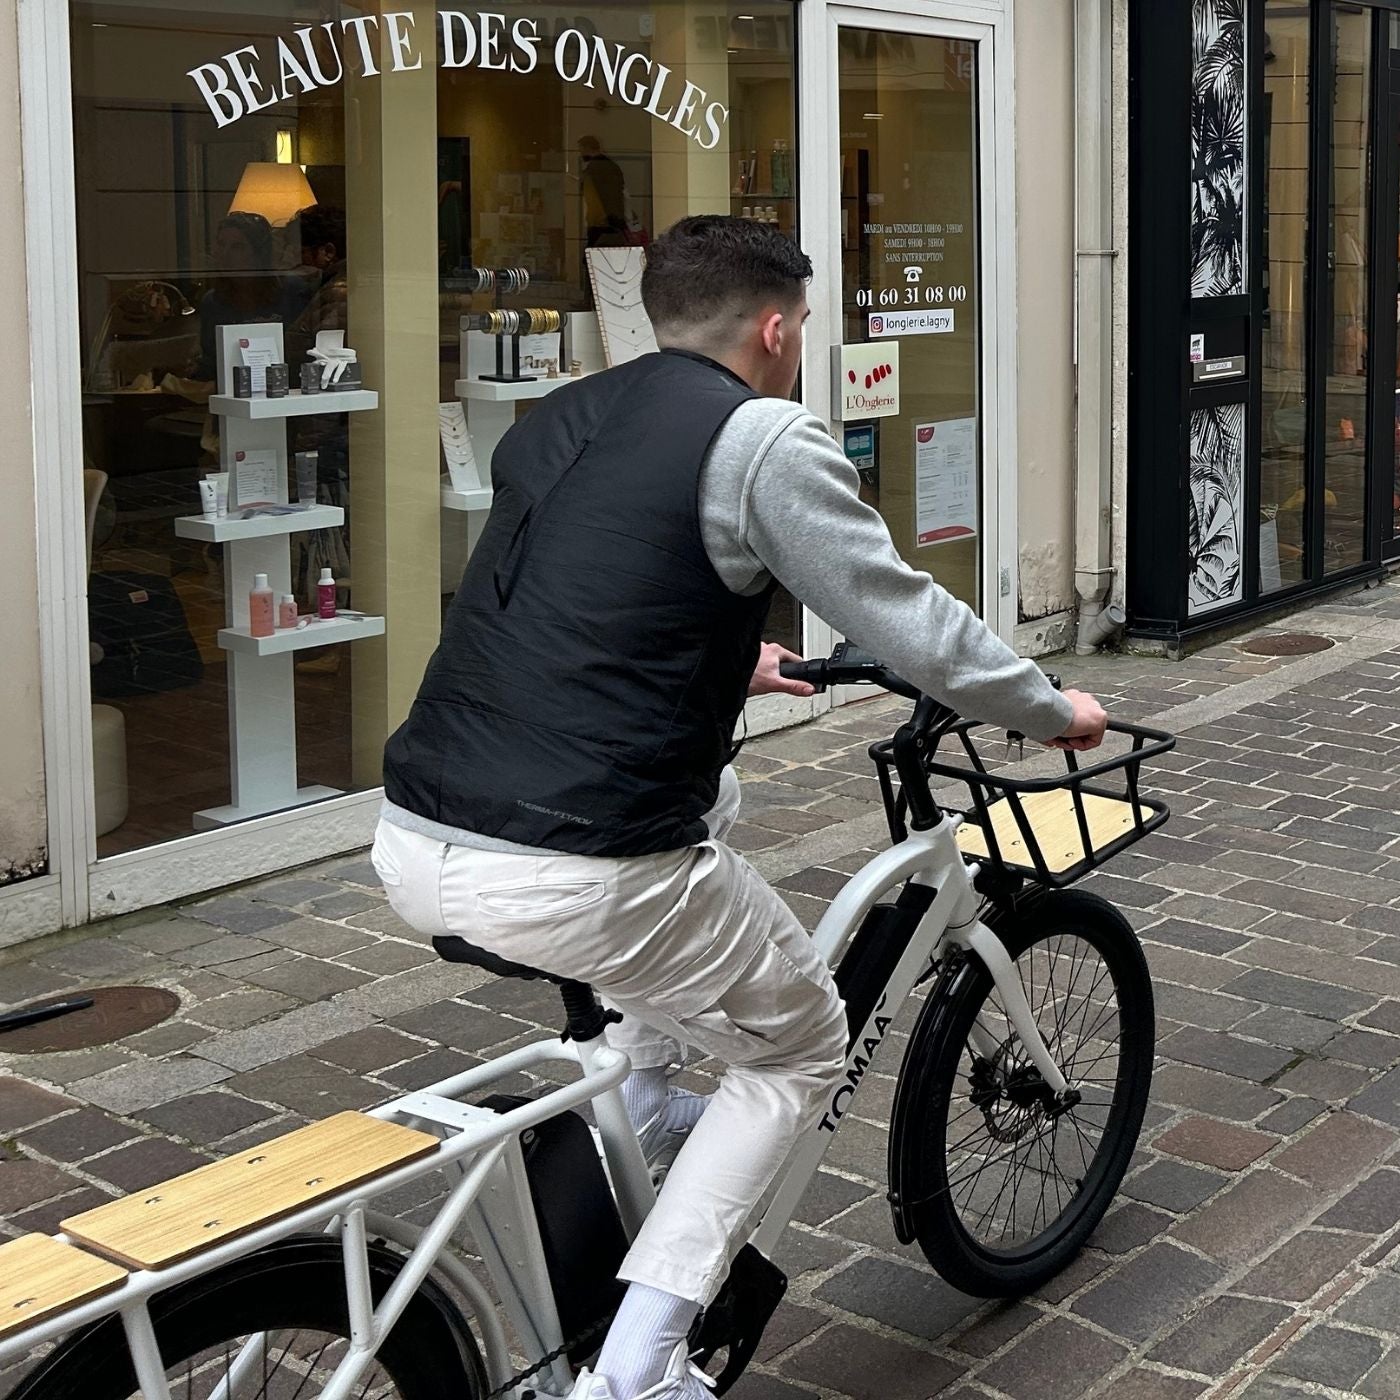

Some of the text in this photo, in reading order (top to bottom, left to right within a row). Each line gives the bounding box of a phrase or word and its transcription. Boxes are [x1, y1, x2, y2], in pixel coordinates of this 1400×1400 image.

[186, 10, 729, 149] BEAUTE DES ONGLES
[864, 223, 885, 234] MARDI
[885, 225, 892, 234] au
[893, 223, 922, 233] VENDREDI
[883, 238, 907, 248] SAMEDI
[885, 252, 944, 263] SANS INTERRUPTION
[856, 285, 967, 307] 01 60 31 08 00
[886, 315, 950, 332] longlerie.lagny
[846, 393, 895, 410] L'Onglerie
